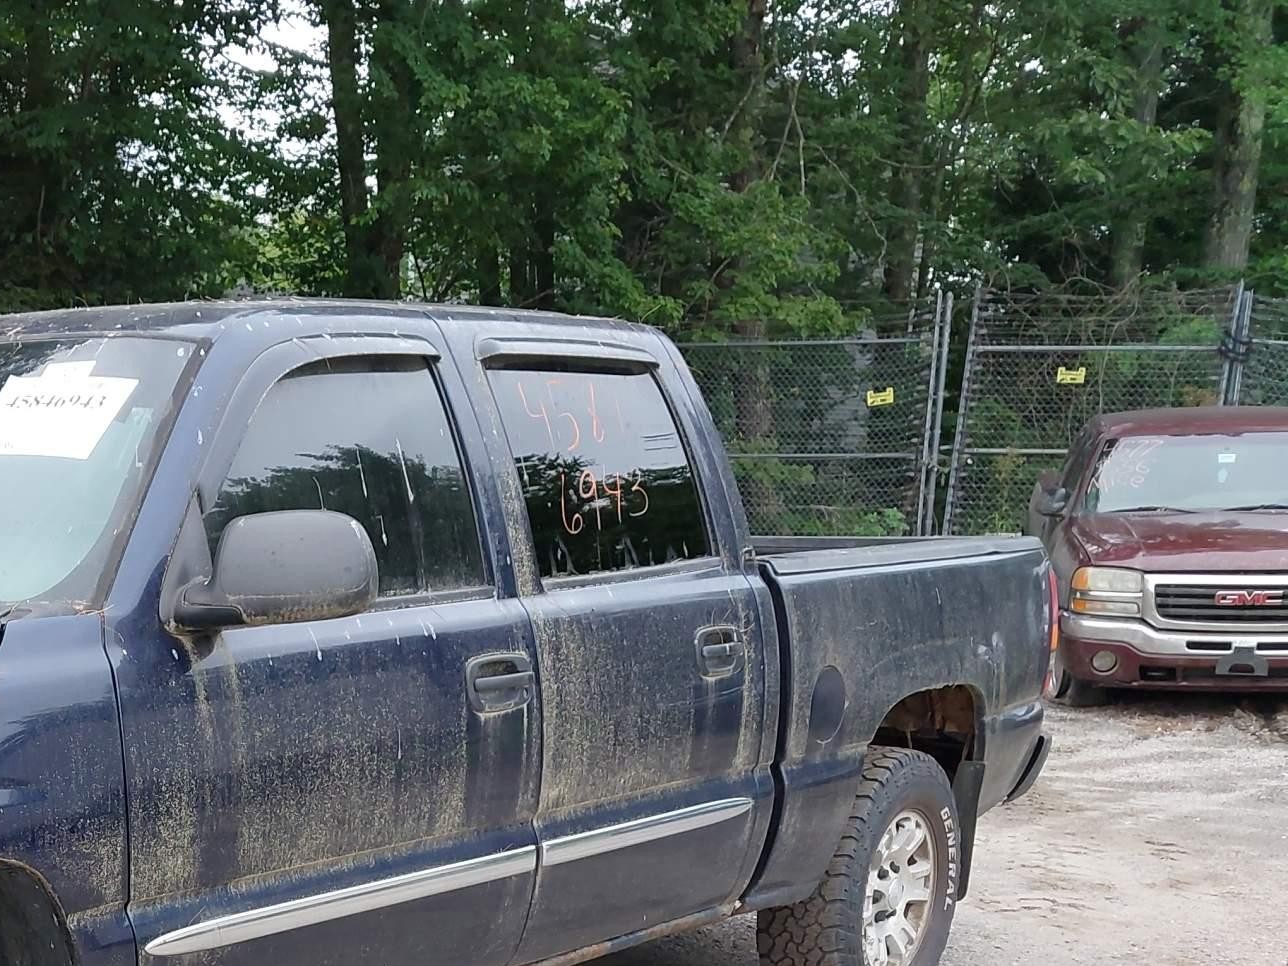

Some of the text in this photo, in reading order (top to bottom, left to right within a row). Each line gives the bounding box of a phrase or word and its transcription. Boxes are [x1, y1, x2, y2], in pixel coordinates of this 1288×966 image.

[6, 393, 107, 409] 45846943
[560, 464, 650, 535] 6943
[1214, 589, 1285, 607] GMC
[939, 805, 958, 912] GENERAL
